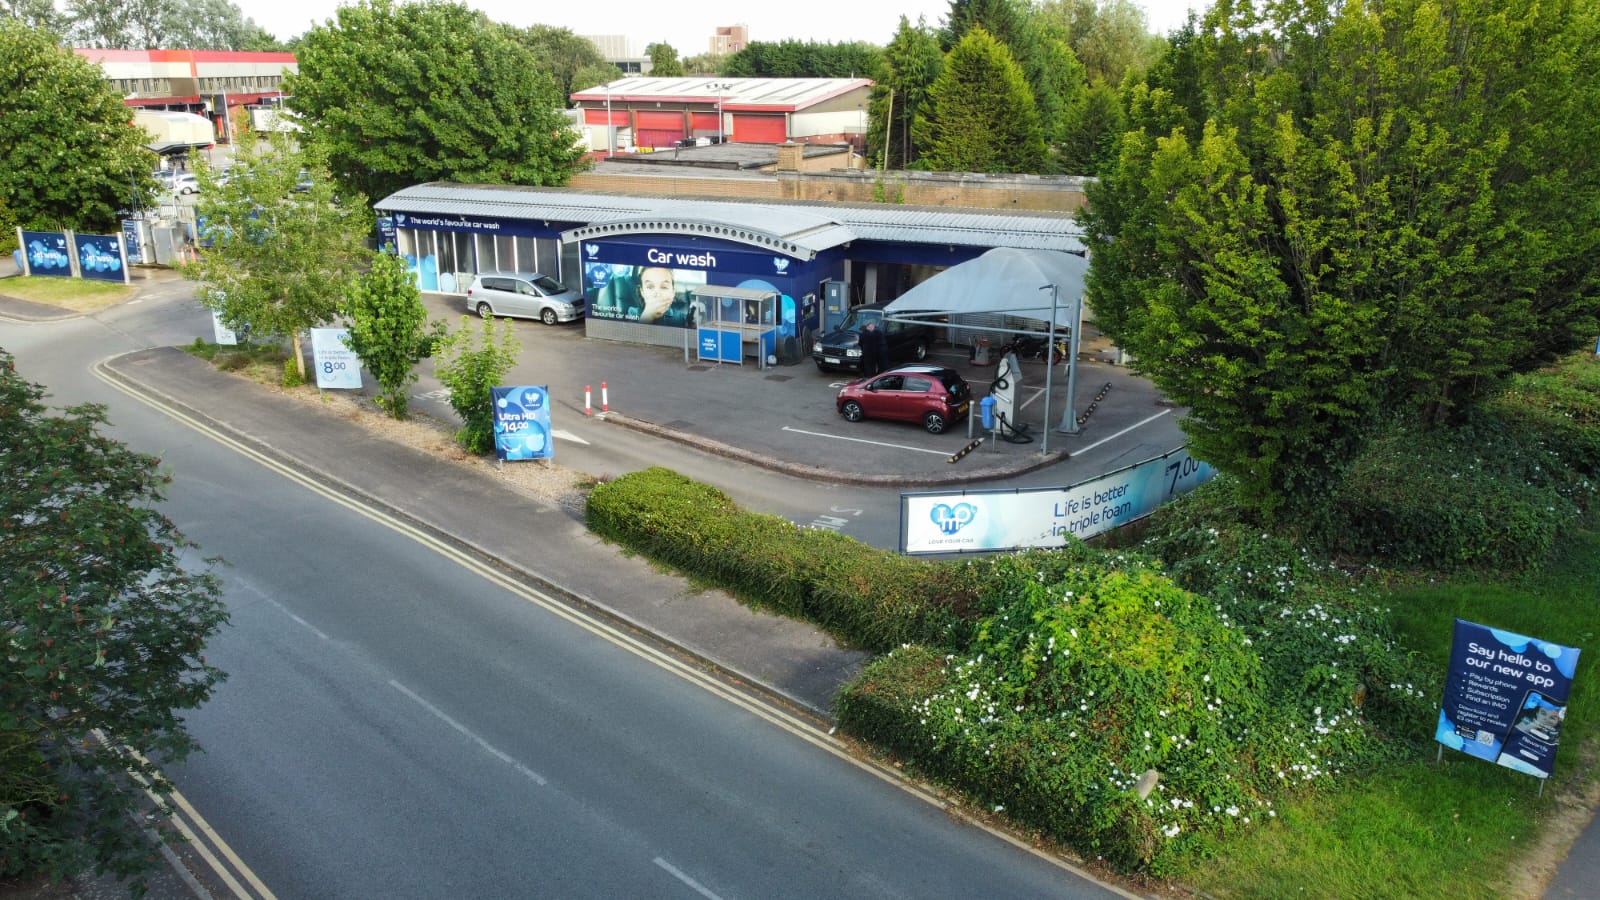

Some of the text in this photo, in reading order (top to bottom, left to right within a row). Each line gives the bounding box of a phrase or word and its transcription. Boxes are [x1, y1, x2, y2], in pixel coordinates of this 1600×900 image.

[444, 218, 472, 228] favourite
[647, 248, 716, 267] Car wash
[1054, 482, 1129, 518] Life is better
[1052, 501, 1131, 536] in triple foam
[1468, 642, 1551, 672] Say hello to
[1466, 657, 1555, 688] our new app
[1469, 672, 1518, 690] Pay by phone
[1468, 680, 1499, 692] Rewards
[1466, 694, 1481, 702] Find
[1492, 701, 1507, 710] IMO
[1467, 687, 1510, 703] Subscription
[1457, 710, 1479, 719] register
[1458, 704, 1487, 716] Download
